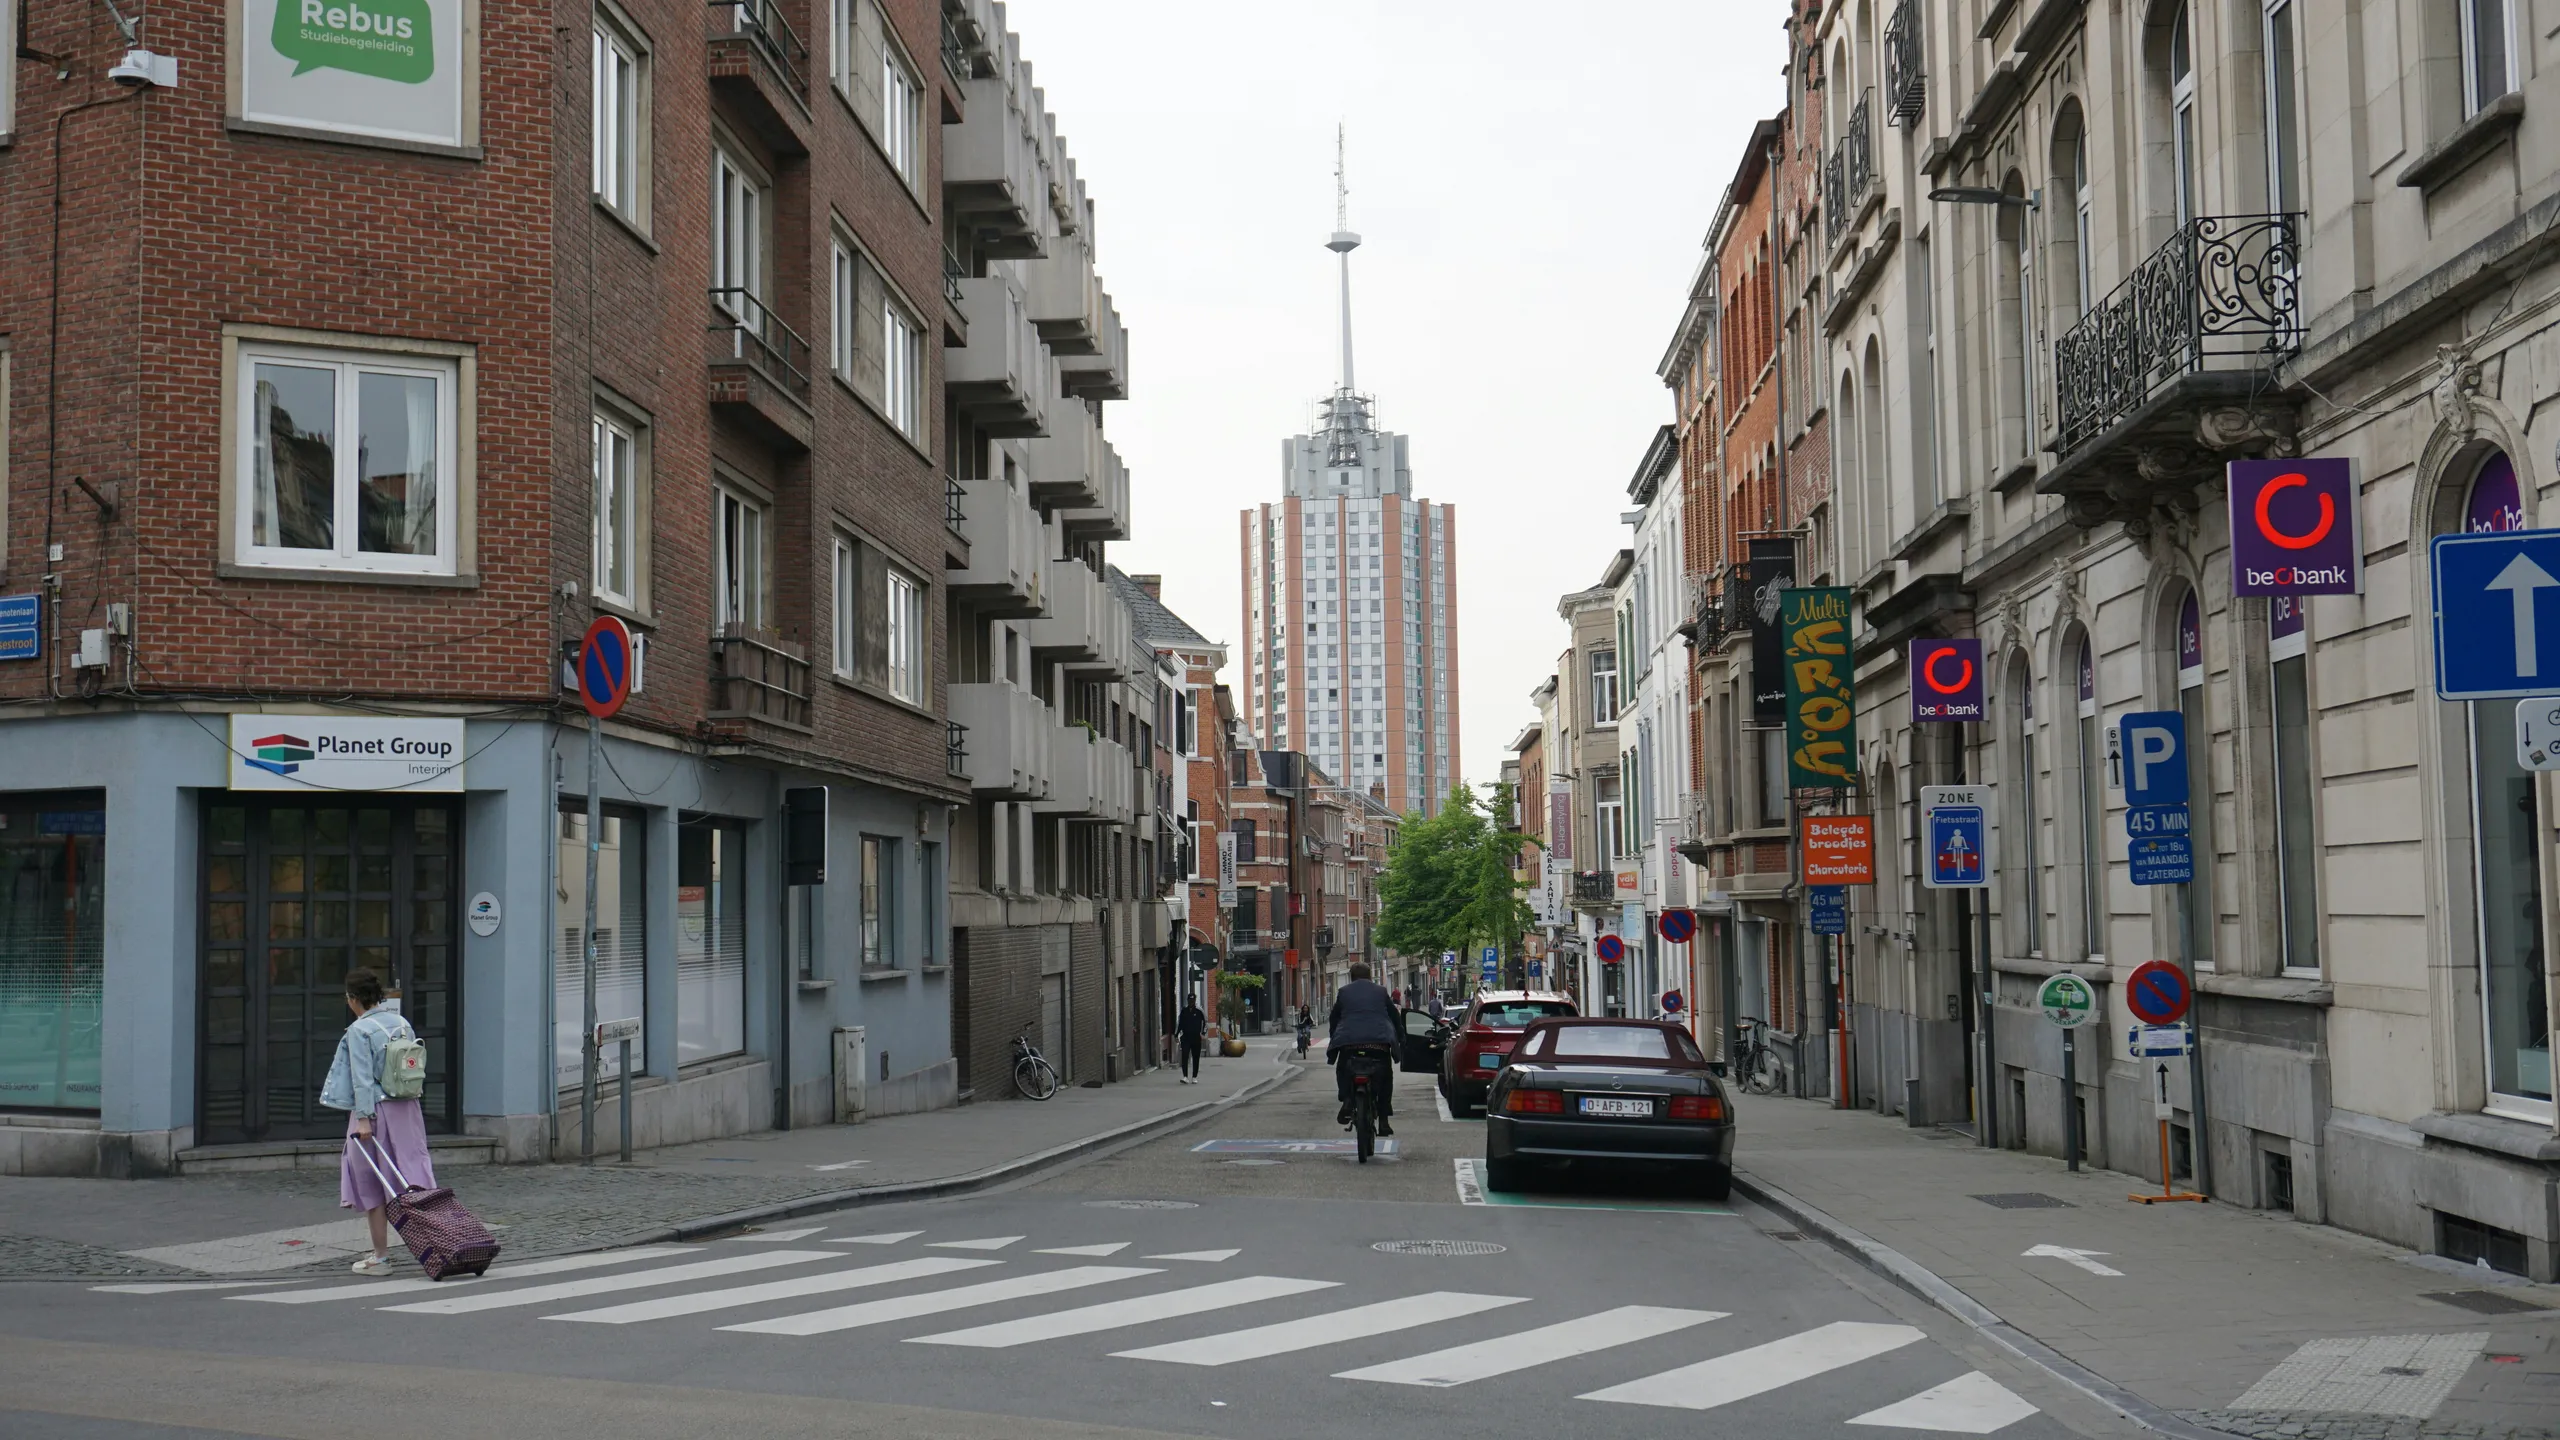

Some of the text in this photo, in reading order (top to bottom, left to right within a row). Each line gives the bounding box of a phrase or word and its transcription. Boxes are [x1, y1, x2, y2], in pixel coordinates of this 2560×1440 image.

[301, 0, 413, 38] Rebus
[300, 29, 414, 56] Studiebegeleiding
[1785, 594, 1849, 625] Multi
[2110, 730, 2117, 739] 6
[318, 736, 452, 759] Planet Group
[2131, 726, 2176, 791] P
[408, 763, 451, 775] Interim
[1938, 793, 1975, 804] ZONE
[1557, 794, 1567, 842] Hairstyling
[1935, 815, 1980, 824] Fietsstraat
[2130, 812, 2188, 832] 45 MIN
[1810, 824, 1865, 838] Belegde
[1808, 837, 1867, 850] broodjes
[2169, 842, 2184, 851] 18u
[2148, 854, 2189, 865] MAANDAG
[1808, 863, 1868, 875] Charcuterie
[2147, 868, 2190, 880] ZATERDAG
[1619, 875, 1635, 883] vdk
[1547, 880, 1555, 921] SAHTAIN
[1812, 895, 1844, 906] 45 MIN
[1273, 931, 1286, 939] CKS
[1486, 949, 1494, 960] P
[1531, 961, 1539, 970] P
[2044, 1009, 2086, 1026] FIETSEXAMEN
